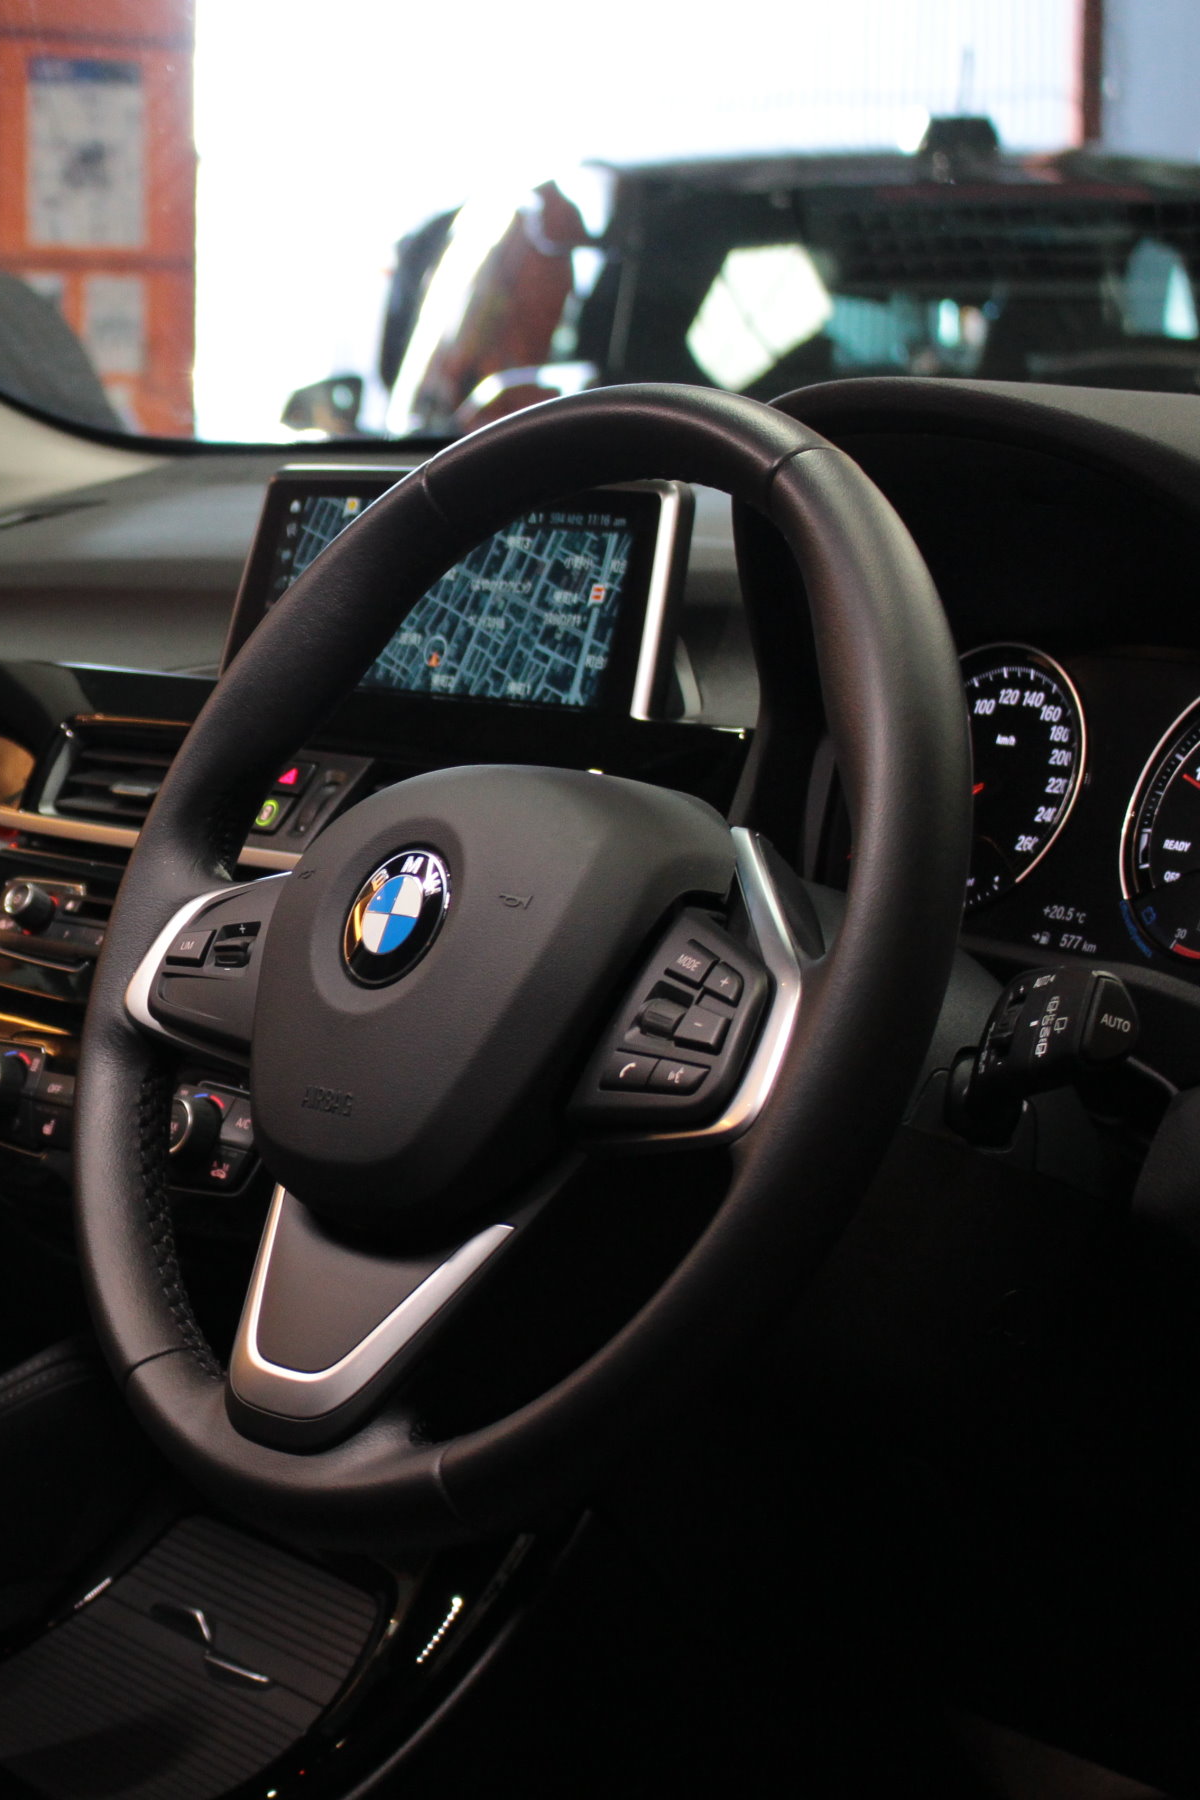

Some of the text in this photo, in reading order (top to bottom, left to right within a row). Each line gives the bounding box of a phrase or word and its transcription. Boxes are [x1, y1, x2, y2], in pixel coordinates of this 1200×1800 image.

[998, 688, 1020, 705] 120
[1022, 690, 1045, 708] 140
[974, 699, 995, 715] 100
[1040, 705, 1062, 722] 160
[995, 734, 1016, 746] km/h
[1049, 725, 1070, 742] 180
[1048, 749, 1072, 766] 200
[1162, 838, 1192, 853] READY
[371, 855, 442, 897] BMW
[1042, 904, 1075, 921] +20.5
[1175, 927, 1188, 940] 30
[180, 941, 195, 951] LIM
[1059, 933, 1097, 953] 577 km
[676, 953, 702, 972] MODE
[1100, 1013, 1131, 1033] AUTO
[301, 1086, 353, 1117] AIRBAG
[235, 1117, 252, 1130] A/C
